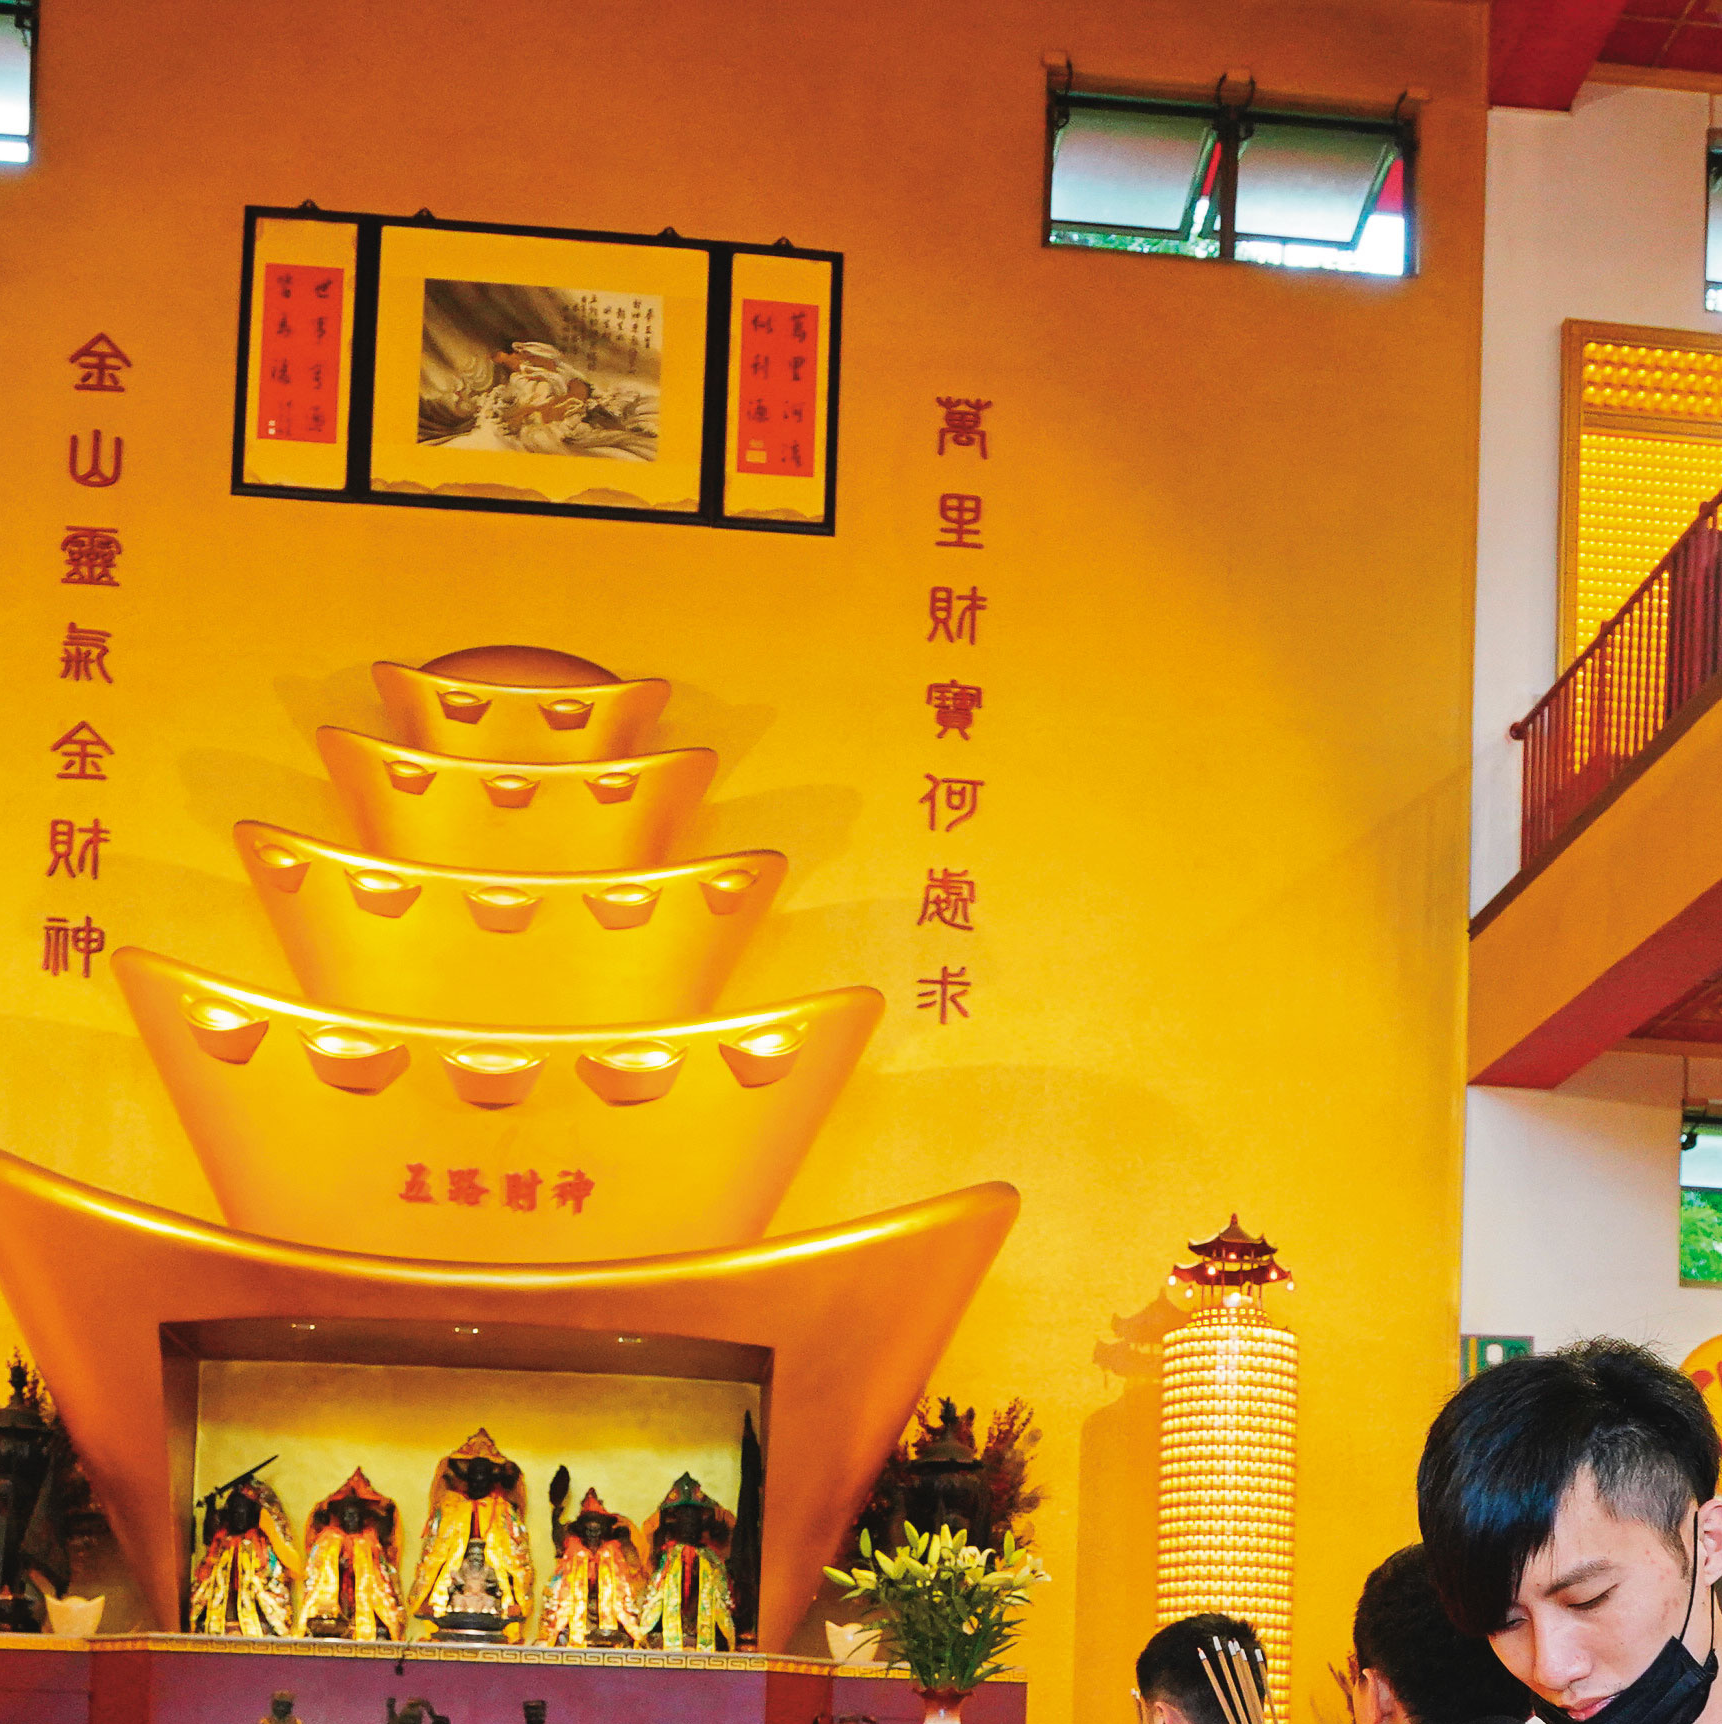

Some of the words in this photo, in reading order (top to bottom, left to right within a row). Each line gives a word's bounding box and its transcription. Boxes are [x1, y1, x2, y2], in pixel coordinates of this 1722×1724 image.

[42, 331, 132, 978] 金山靈氣金財神
[915, 397, 992, 1025] 萬里財寶何處求
[397, 1163, 596, 1214] 五路財神
